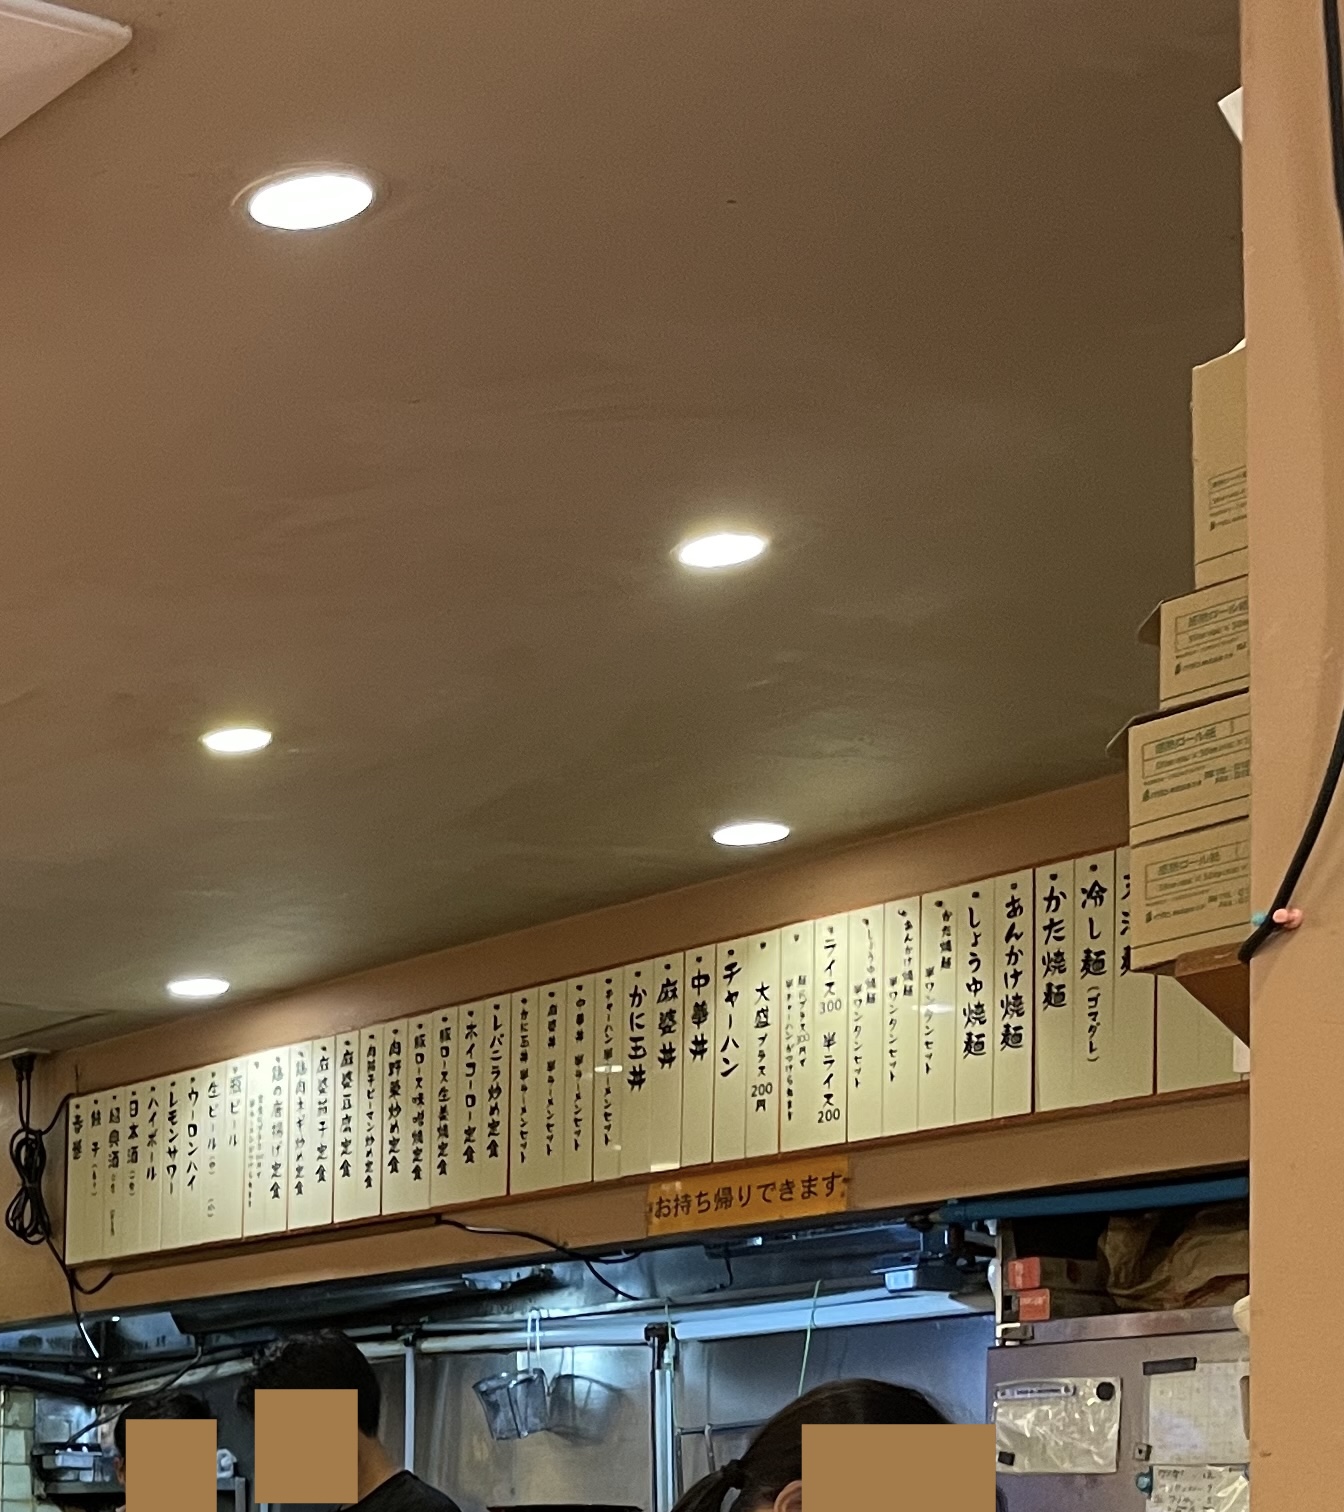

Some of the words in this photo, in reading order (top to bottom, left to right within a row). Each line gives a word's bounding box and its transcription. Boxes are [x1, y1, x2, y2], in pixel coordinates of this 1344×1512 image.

[1000, 895, 1025, 1052] あんかけ焼麺
[1042, 885, 1067, 1012] かた焼麺
[627, 985, 647, 1092] かに玉丼
[657, 977, 678, 1069] 麻婆丼
[690, 968, 710, 1062] 中華丼
[720, 961, 742, 1077] チャーハン
[146, 1097, 159, 1180] ハイボール
[185, 1089, 199, 1190] ウーロンハイ
[340, 1050, 353, 1177] 麻婆豆腐定食
[387, 1039, 402, 1174] 肉野菜炒め定食
[463, 1023, 478, 1163] ホイコーロー定食
[487, 1014, 504, 1158] レバニラ炒め定食
[166, 1091, 179, 1195] レモンサワー
[655, 1171, 842, 1219] お持ち帰りできます
